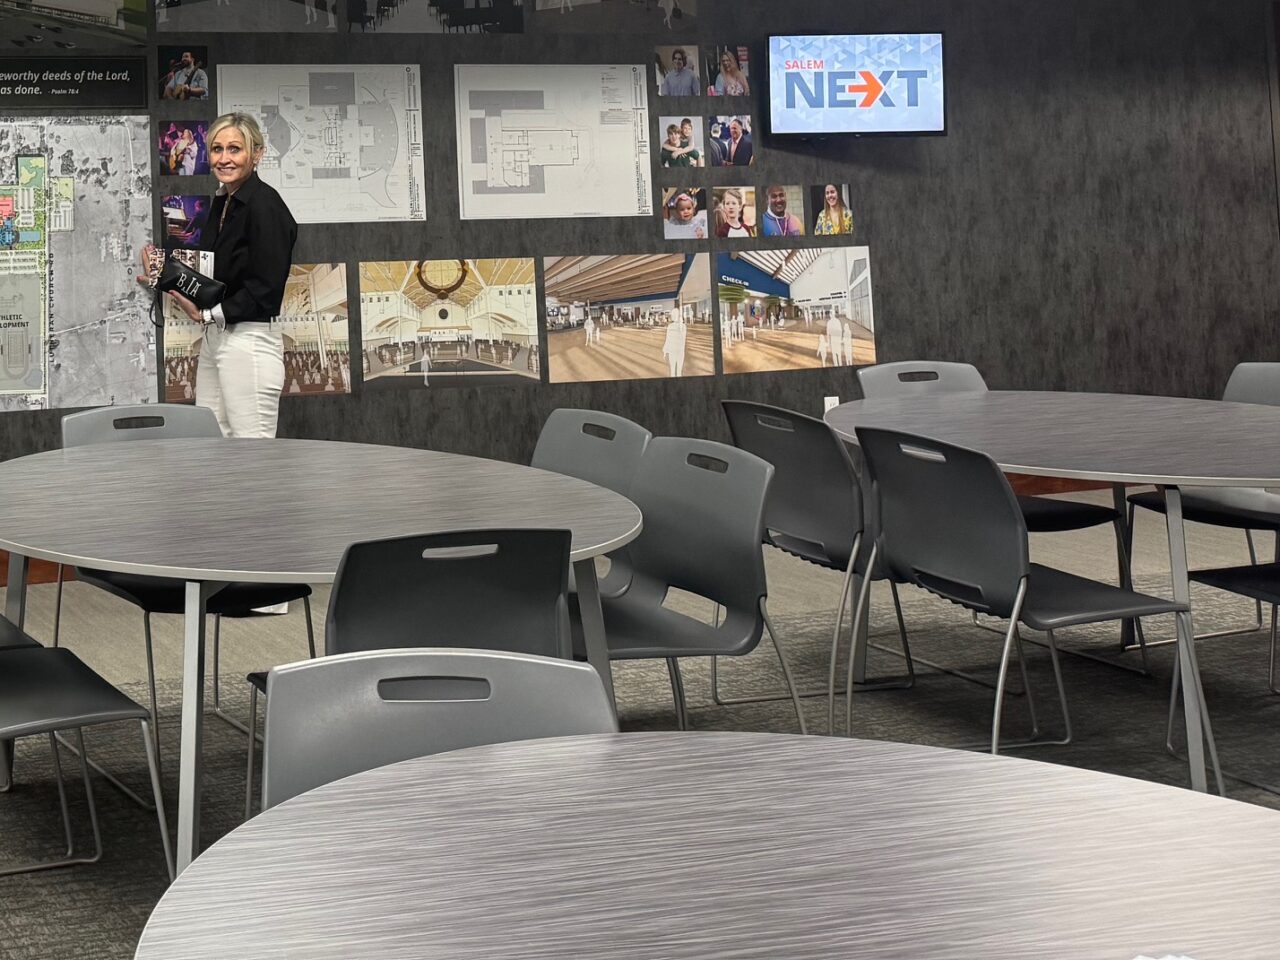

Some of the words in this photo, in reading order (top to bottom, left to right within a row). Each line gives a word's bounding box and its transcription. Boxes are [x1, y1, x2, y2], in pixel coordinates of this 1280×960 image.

[784, 59, 824, 70] SALEM
[42, 70, 72, 81] deeds
[73, 70, 86, 84] of
[86, 70, 104, 81] the
[105, 70, 131, 82] Lord,
[14, 84, 43, 95] done.
[51, 87, 67, 95] Psalm
[784, 70, 928, 109] NEXT
